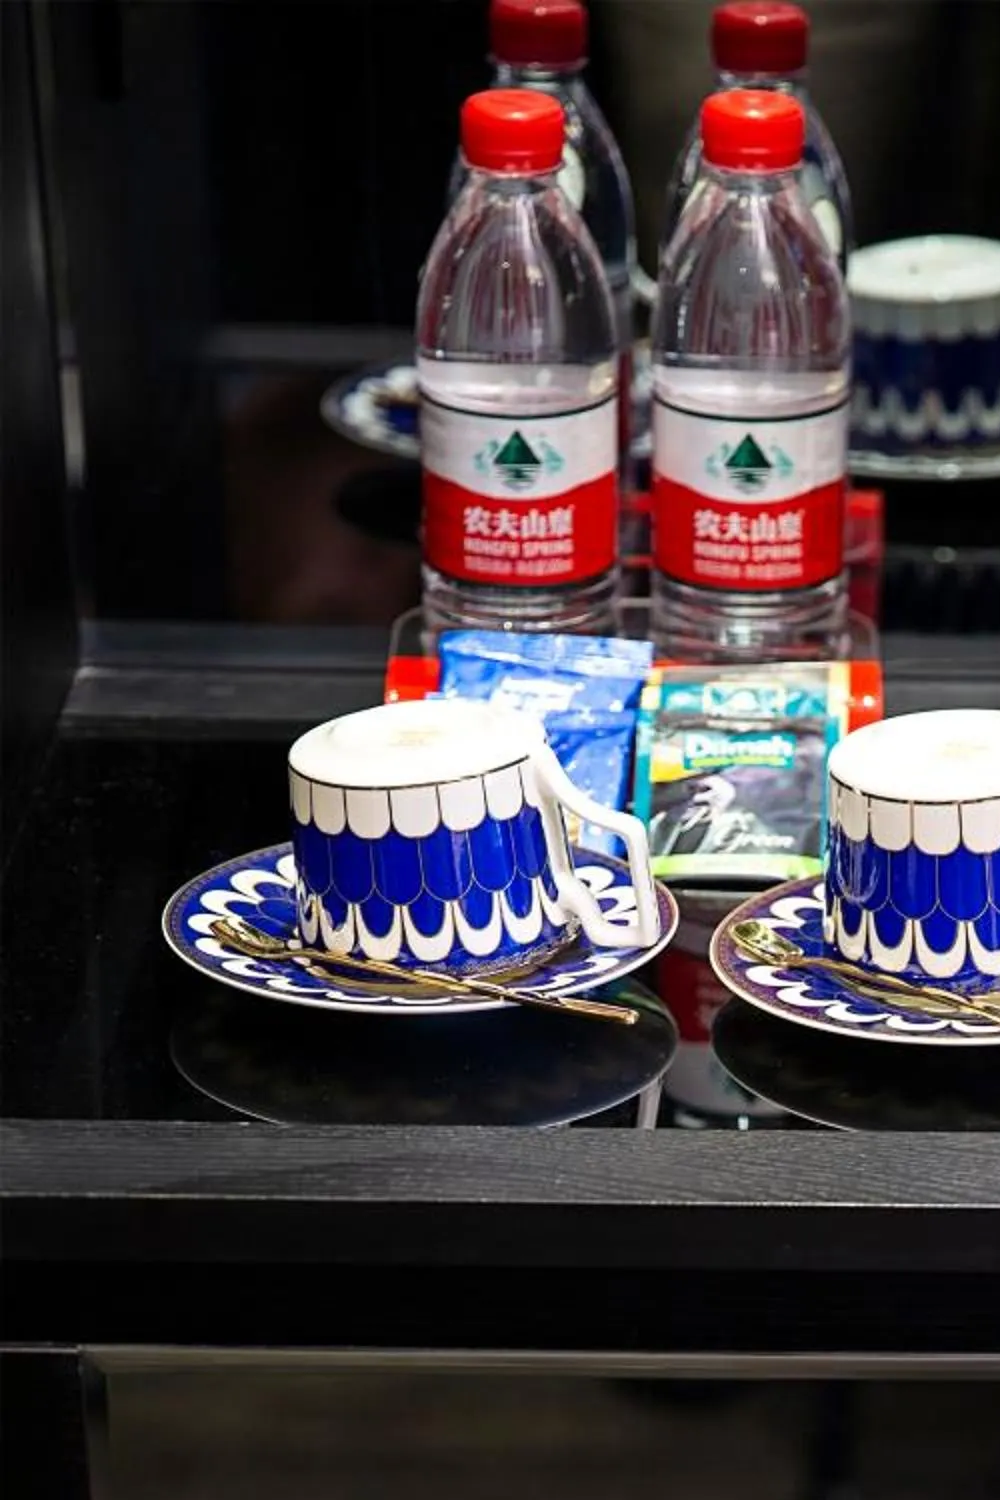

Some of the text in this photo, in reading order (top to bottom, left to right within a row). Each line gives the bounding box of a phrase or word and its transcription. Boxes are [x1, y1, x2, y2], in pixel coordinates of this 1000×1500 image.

[464, 506, 574, 539] 农夫山泉
[694, 509, 803, 543] 农夫山泉
